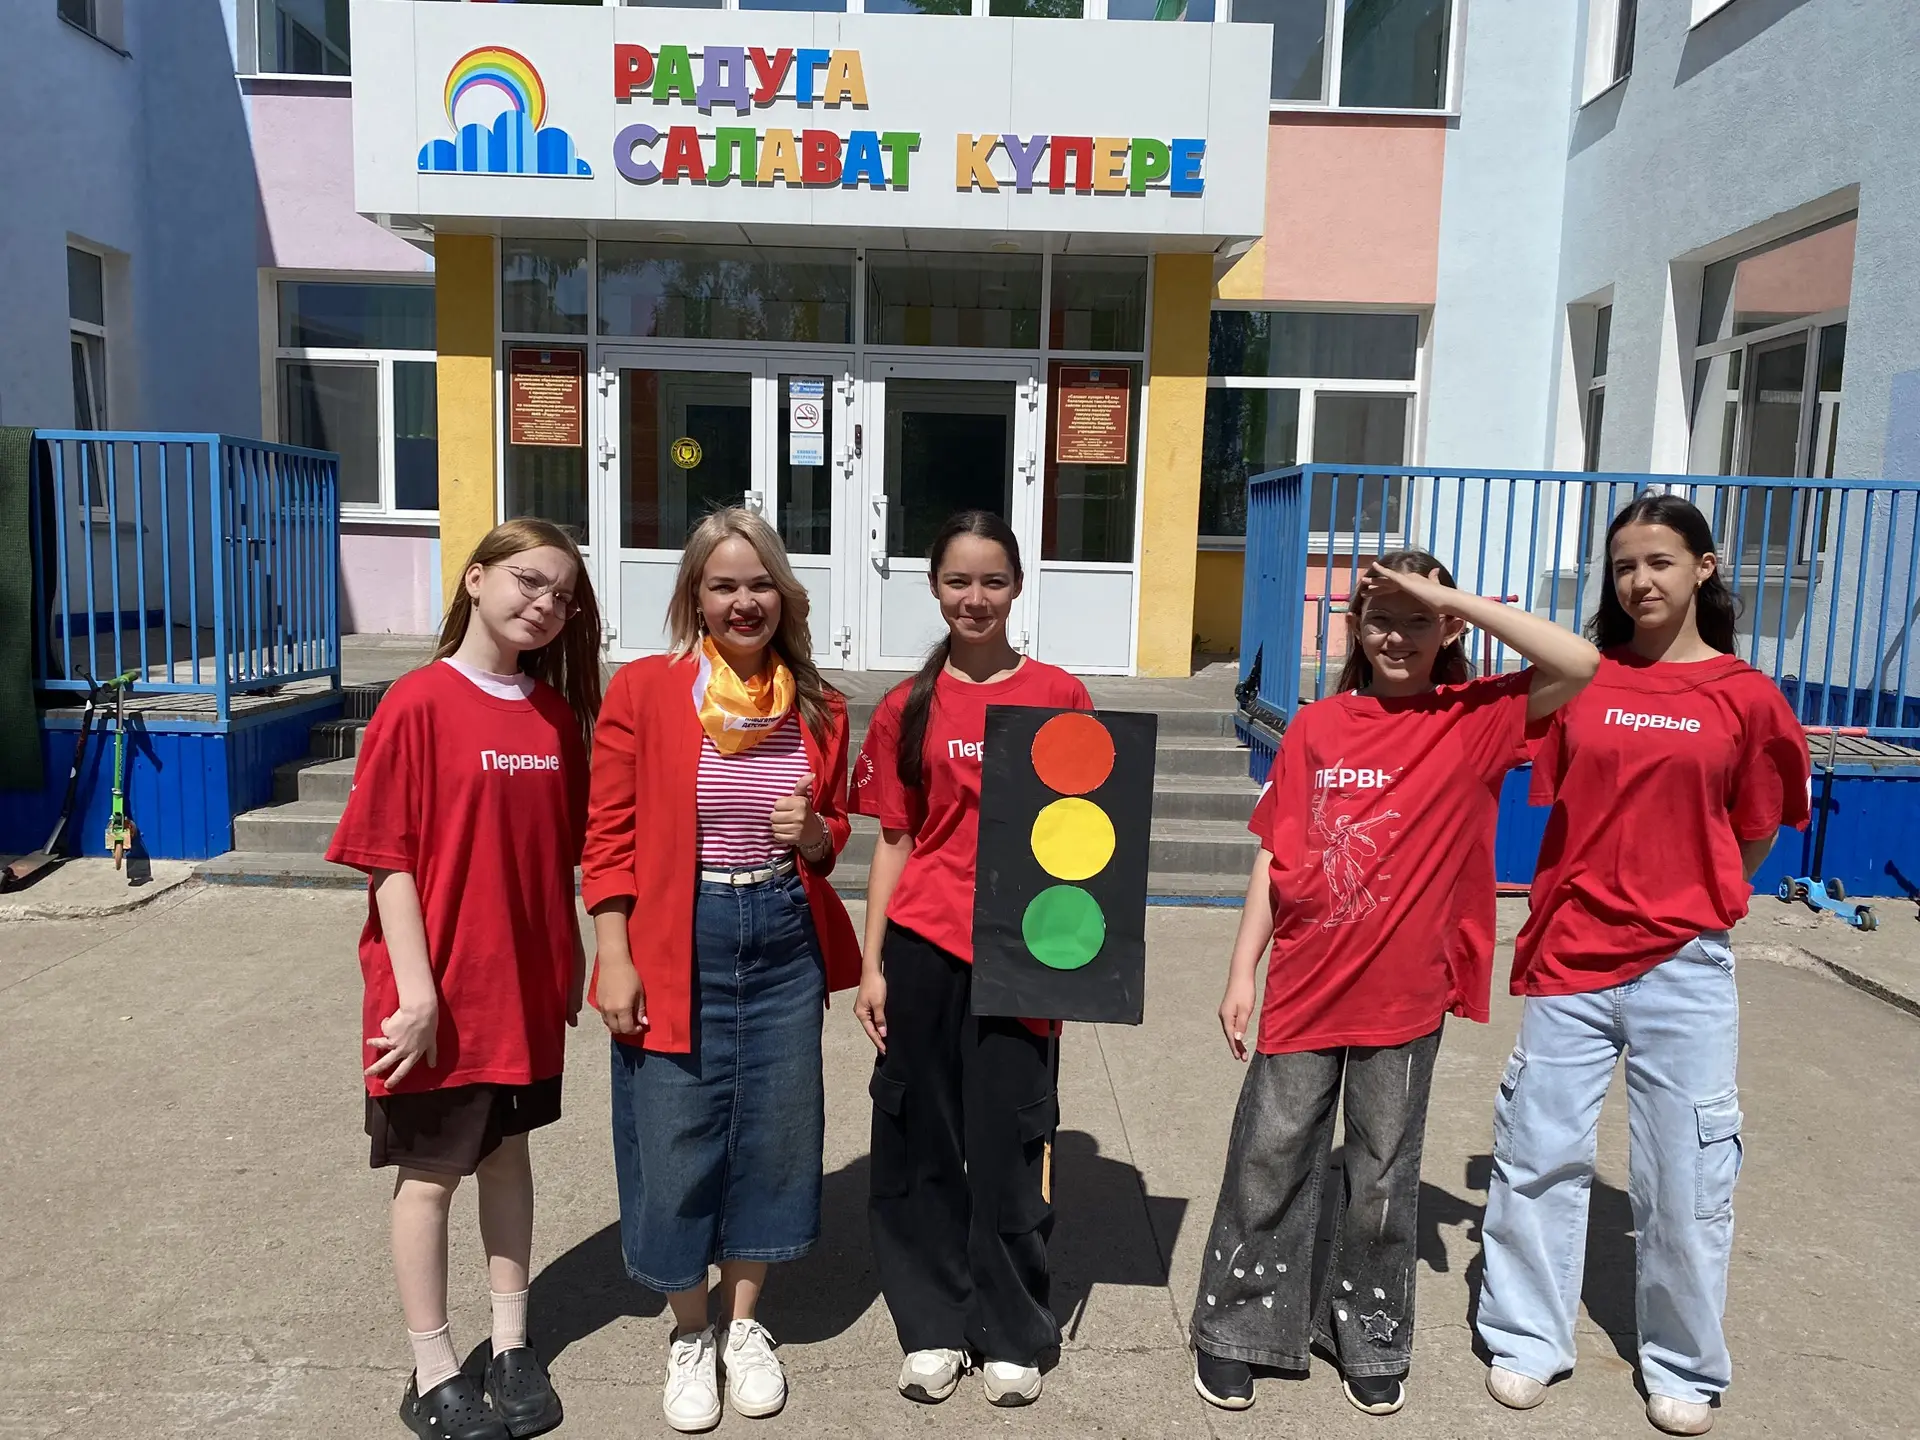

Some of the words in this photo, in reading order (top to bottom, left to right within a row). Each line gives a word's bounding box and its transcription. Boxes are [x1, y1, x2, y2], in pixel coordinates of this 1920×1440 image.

[614, 44, 868, 112] РАДУГА
[613, 123, 921, 188] САЛАВАТ
[1604, 708, 1701, 733] Первые
[480, 749, 560, 776] Первые
